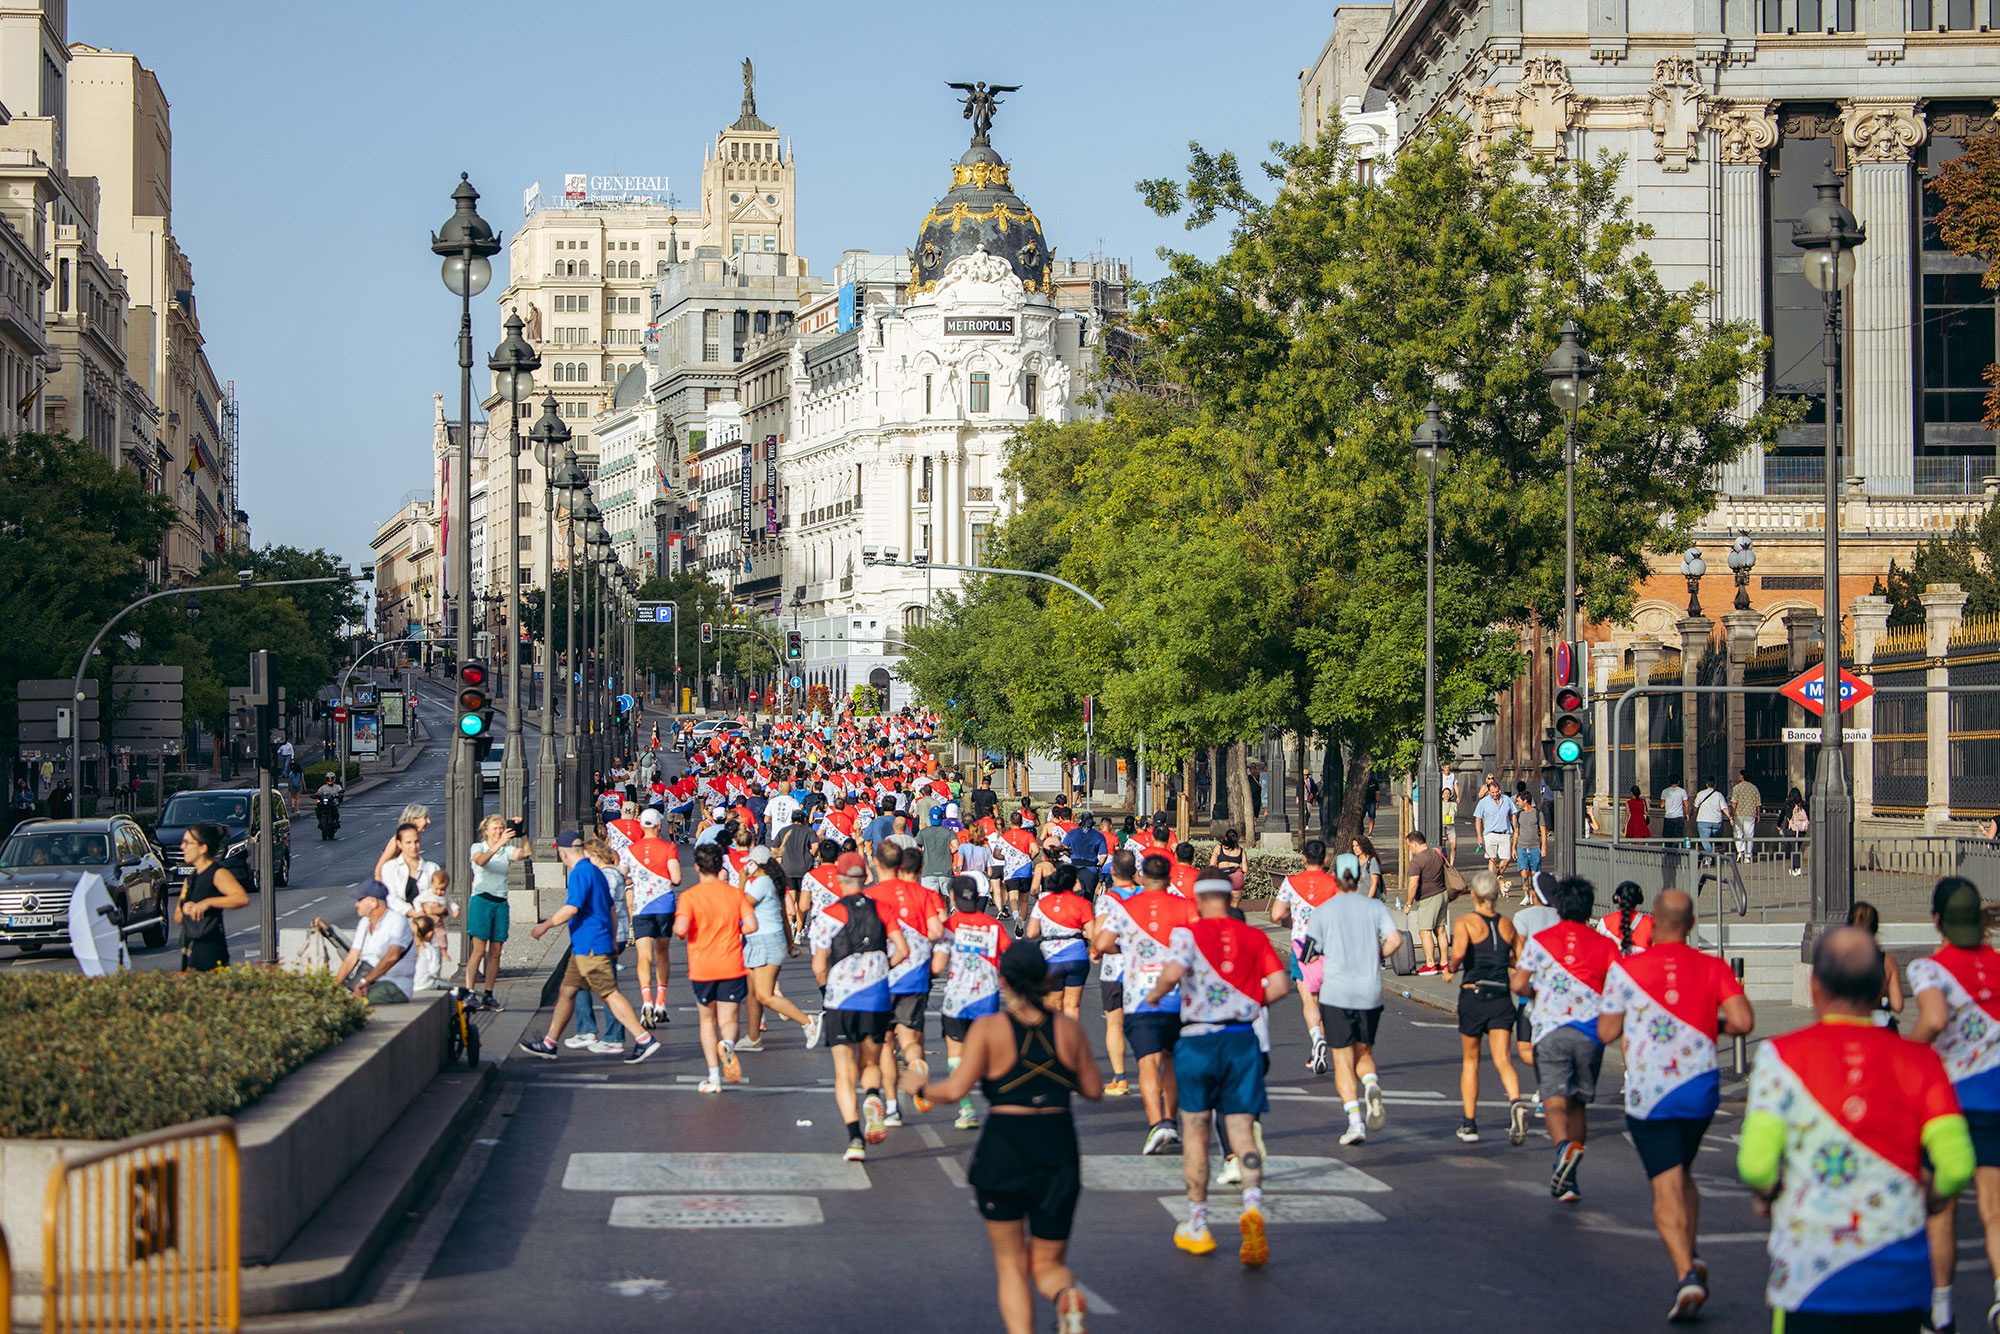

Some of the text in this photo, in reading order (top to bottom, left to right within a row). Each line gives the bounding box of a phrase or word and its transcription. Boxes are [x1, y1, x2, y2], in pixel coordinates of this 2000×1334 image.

[590, 175, 671, 191] GENERALI
[947, 320, 1012, 331] METROPOLIS
[742, 468, 750, 537] POR SER MUJERES
[660, 609, 668, 620] P
[1787, 730, 1867, 741] Banco paña
[14, 916, 34, 925] 7472
